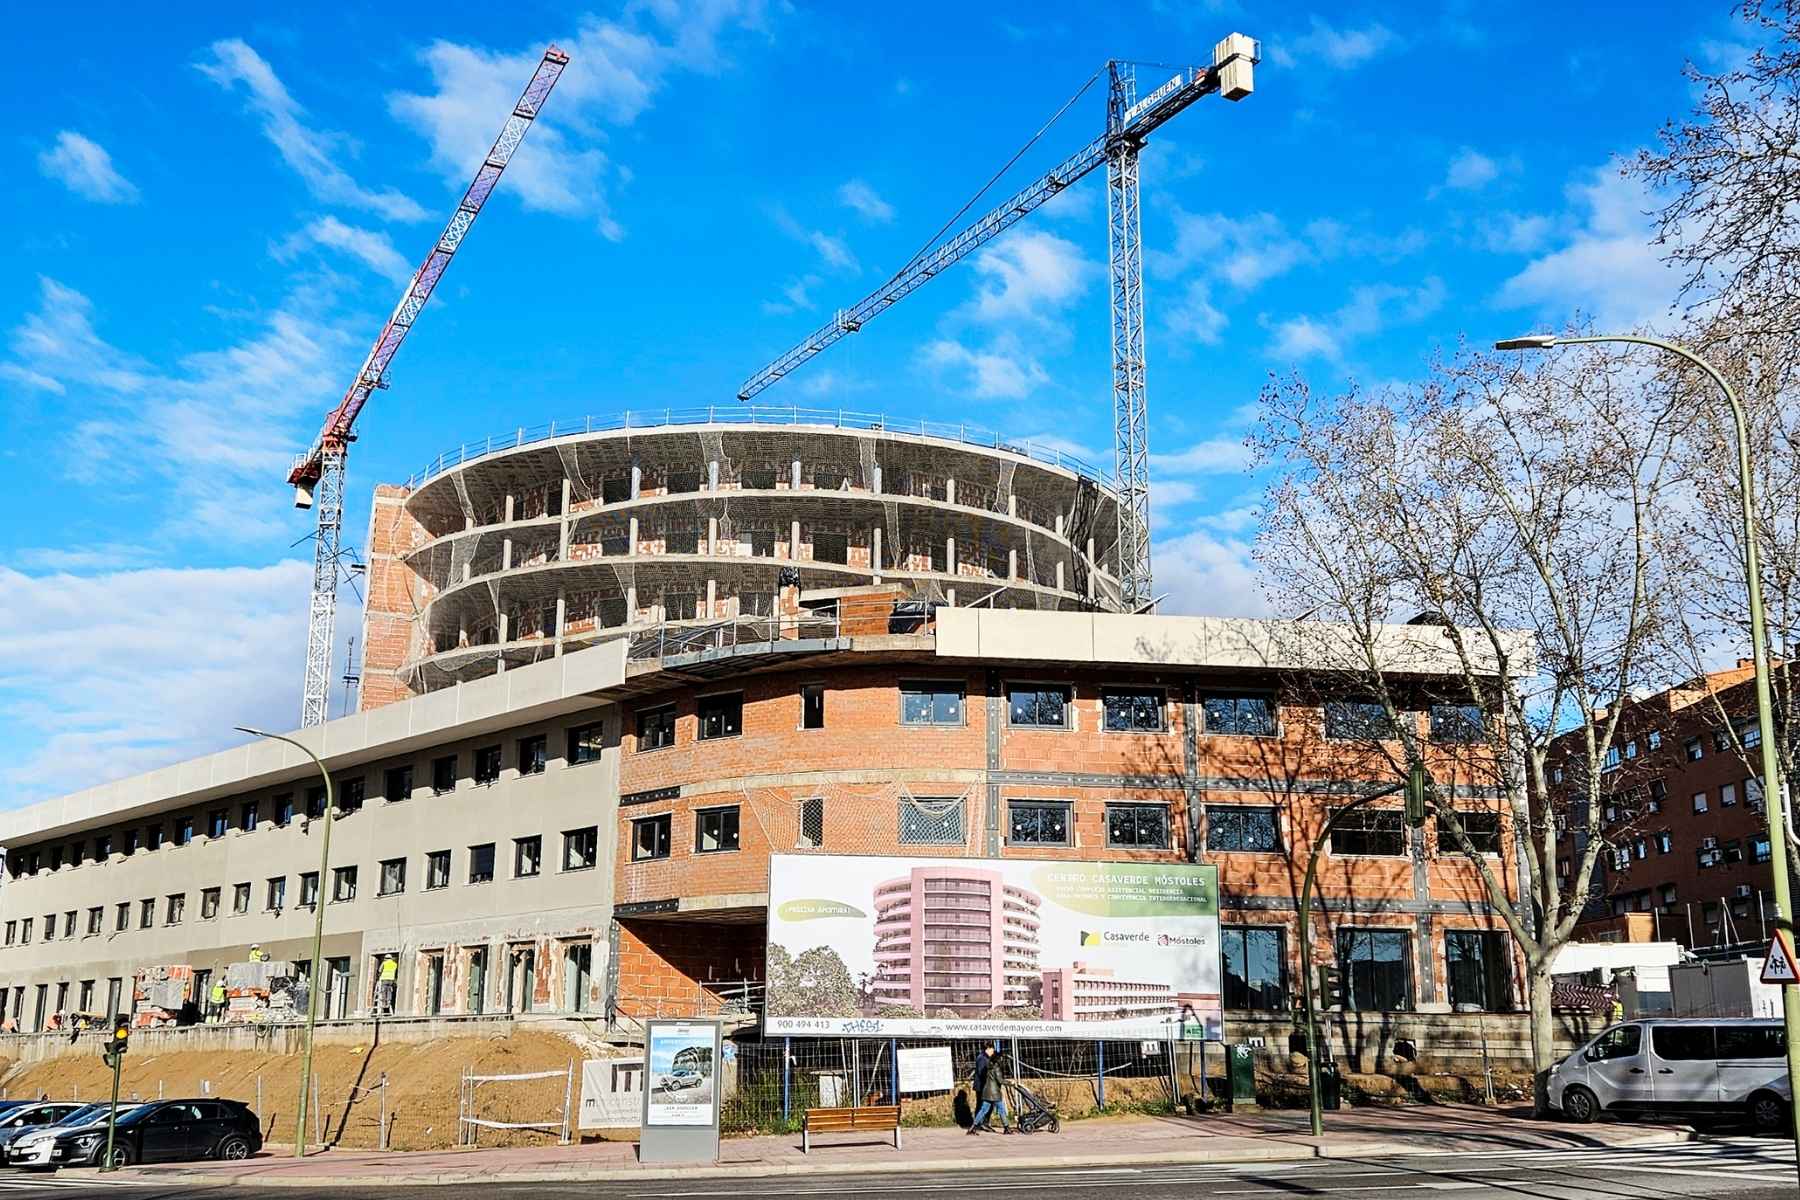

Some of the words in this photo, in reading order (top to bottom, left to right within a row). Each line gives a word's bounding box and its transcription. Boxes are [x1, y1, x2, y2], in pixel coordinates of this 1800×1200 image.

[1048, 873, 1085, 882] CENTRO
[1091, 874, 1149, 884] CASAVERDE
[1154, 874, 1205, 886] MÓSTOLES
[1103, 931, 1150, 942] Casaverde
[1170, 935, 1206, 946] Móstoles
[777, 1020, 793, 1029] 900
[796, 1020, 812, 1029] 494
[814, 1020, 831, 1029] 413
[945, 1023, 1062, 1034] www.casaverdemayores.com
